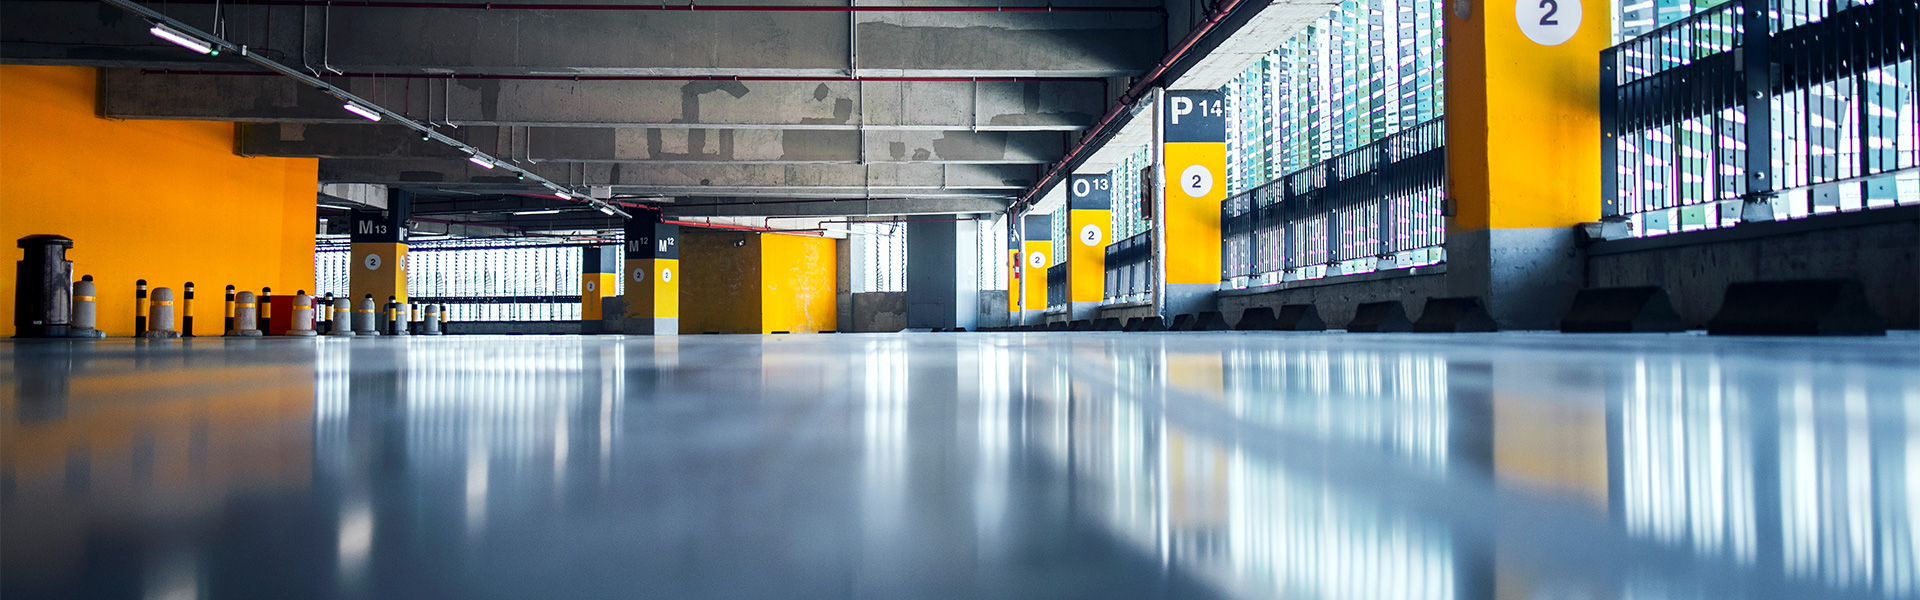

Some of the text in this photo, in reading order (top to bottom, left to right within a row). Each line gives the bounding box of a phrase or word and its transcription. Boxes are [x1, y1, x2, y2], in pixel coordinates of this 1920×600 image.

[1539, 0, 1558, 26] 2
[1191, 174, 1202, 188] 2
[1088, 231, 1095, 240] 2
[370, 258, 376, 266] 2
[1034, 256, 1041, 264] 2
[636, 271, 641, 279] 2
